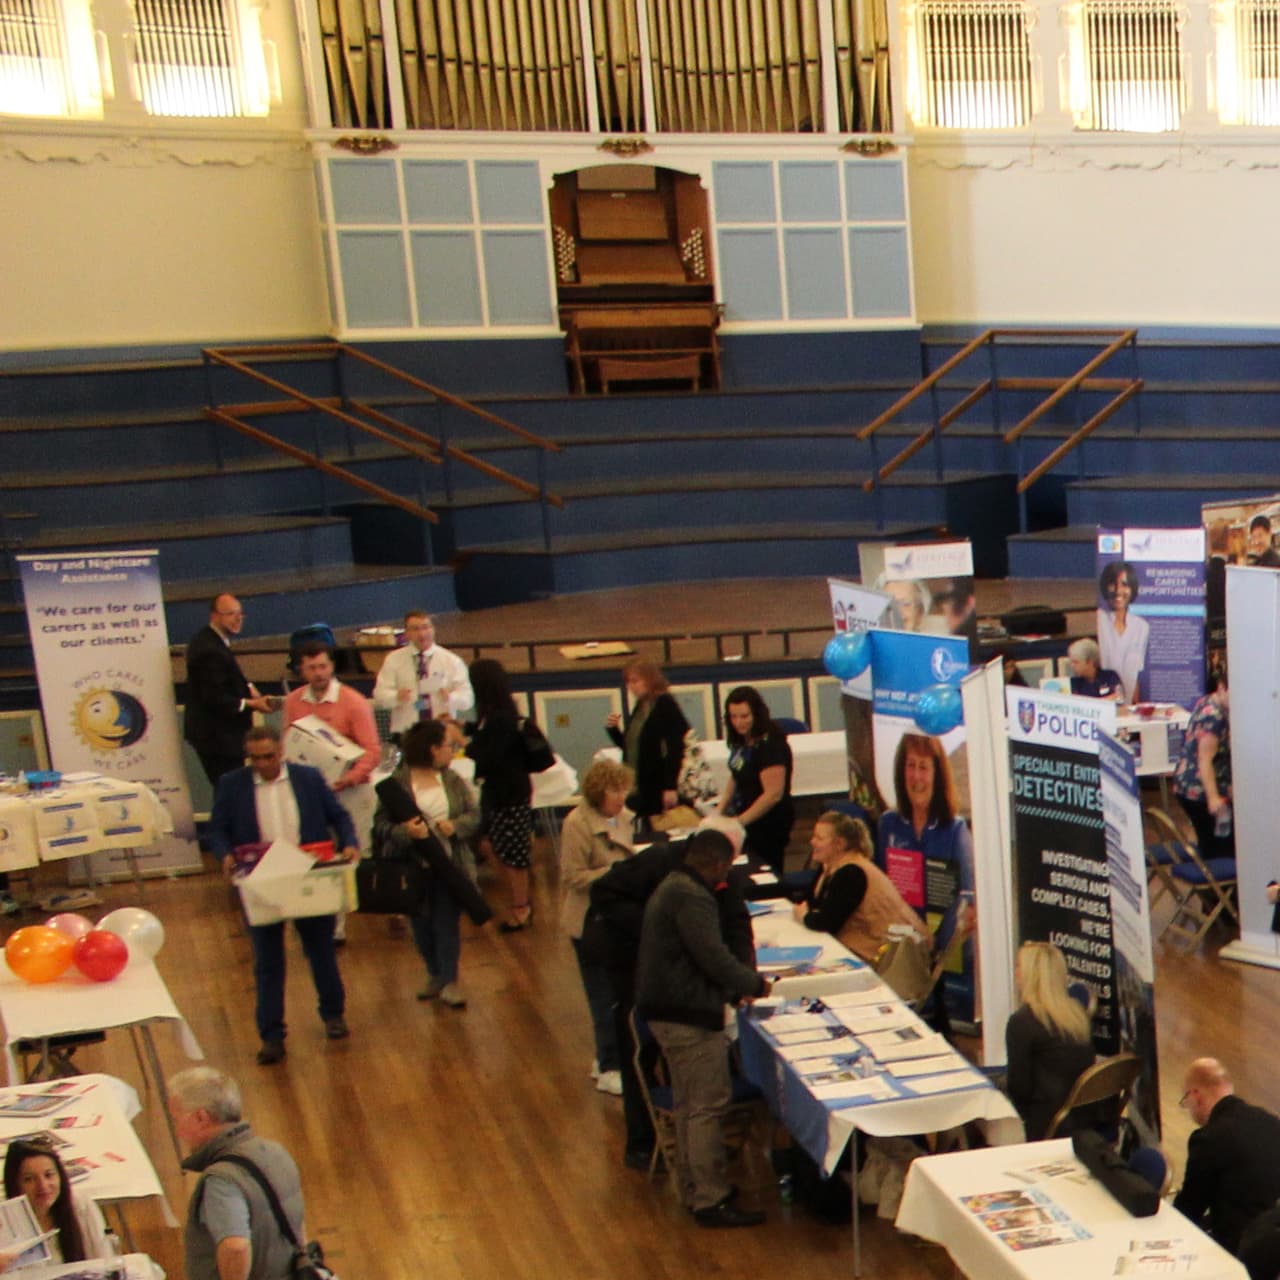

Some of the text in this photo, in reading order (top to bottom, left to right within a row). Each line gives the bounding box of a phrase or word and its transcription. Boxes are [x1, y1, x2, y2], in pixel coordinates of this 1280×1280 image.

[1154, 578, 1188, 586] CAREER
[72, 604, 102, 615] care
[106, 601, 128, 614] for
[133, 601, 158, 612] our
[42, 617, 158, 634] carers as well as
[60, 638, 85, 649] our
[1013, 753, 1071, 779] SPECIALIST
[1013, 772, 1104, 812] DETECTIVES
[1041, 849, 1110, 877] INVESTIGATING
[1050, 871, 1110, 897] SERIOUS AND
[1031, 888, 1110, 921] COMPLEX CASES,
[1080, 919, 1110, 937] WE'RE
[1050, 930, 1111, 959] LOOKING FOR
[1066, 955, 1111, 979] TALENTED
